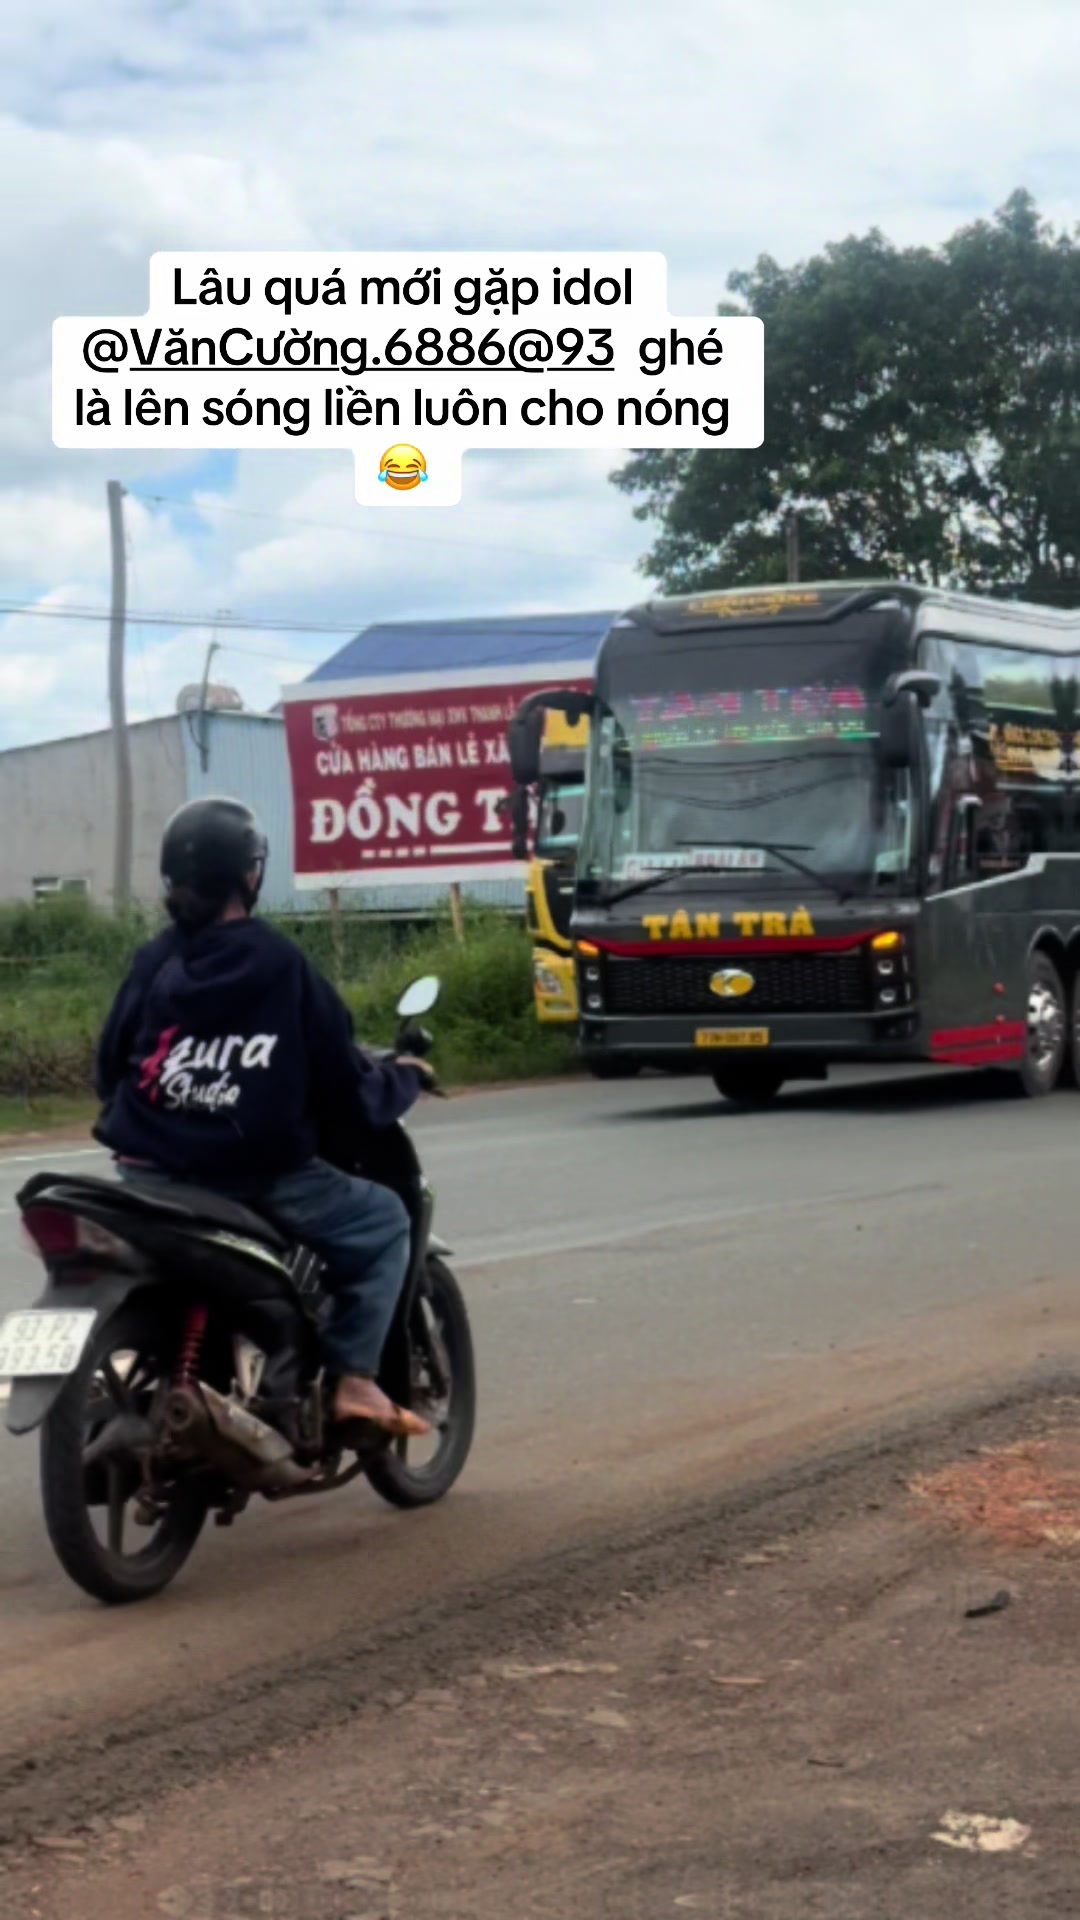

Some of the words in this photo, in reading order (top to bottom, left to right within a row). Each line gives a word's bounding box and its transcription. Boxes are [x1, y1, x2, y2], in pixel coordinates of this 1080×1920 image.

[316, 740, 354, 775] CỬA
[356, 740, 410, 772] HÀNG
[412, 735, 452, 769] BÁN
[310, 777, 462, 844] ĐỒNG
[642, 907, 721, 941] TÂN
